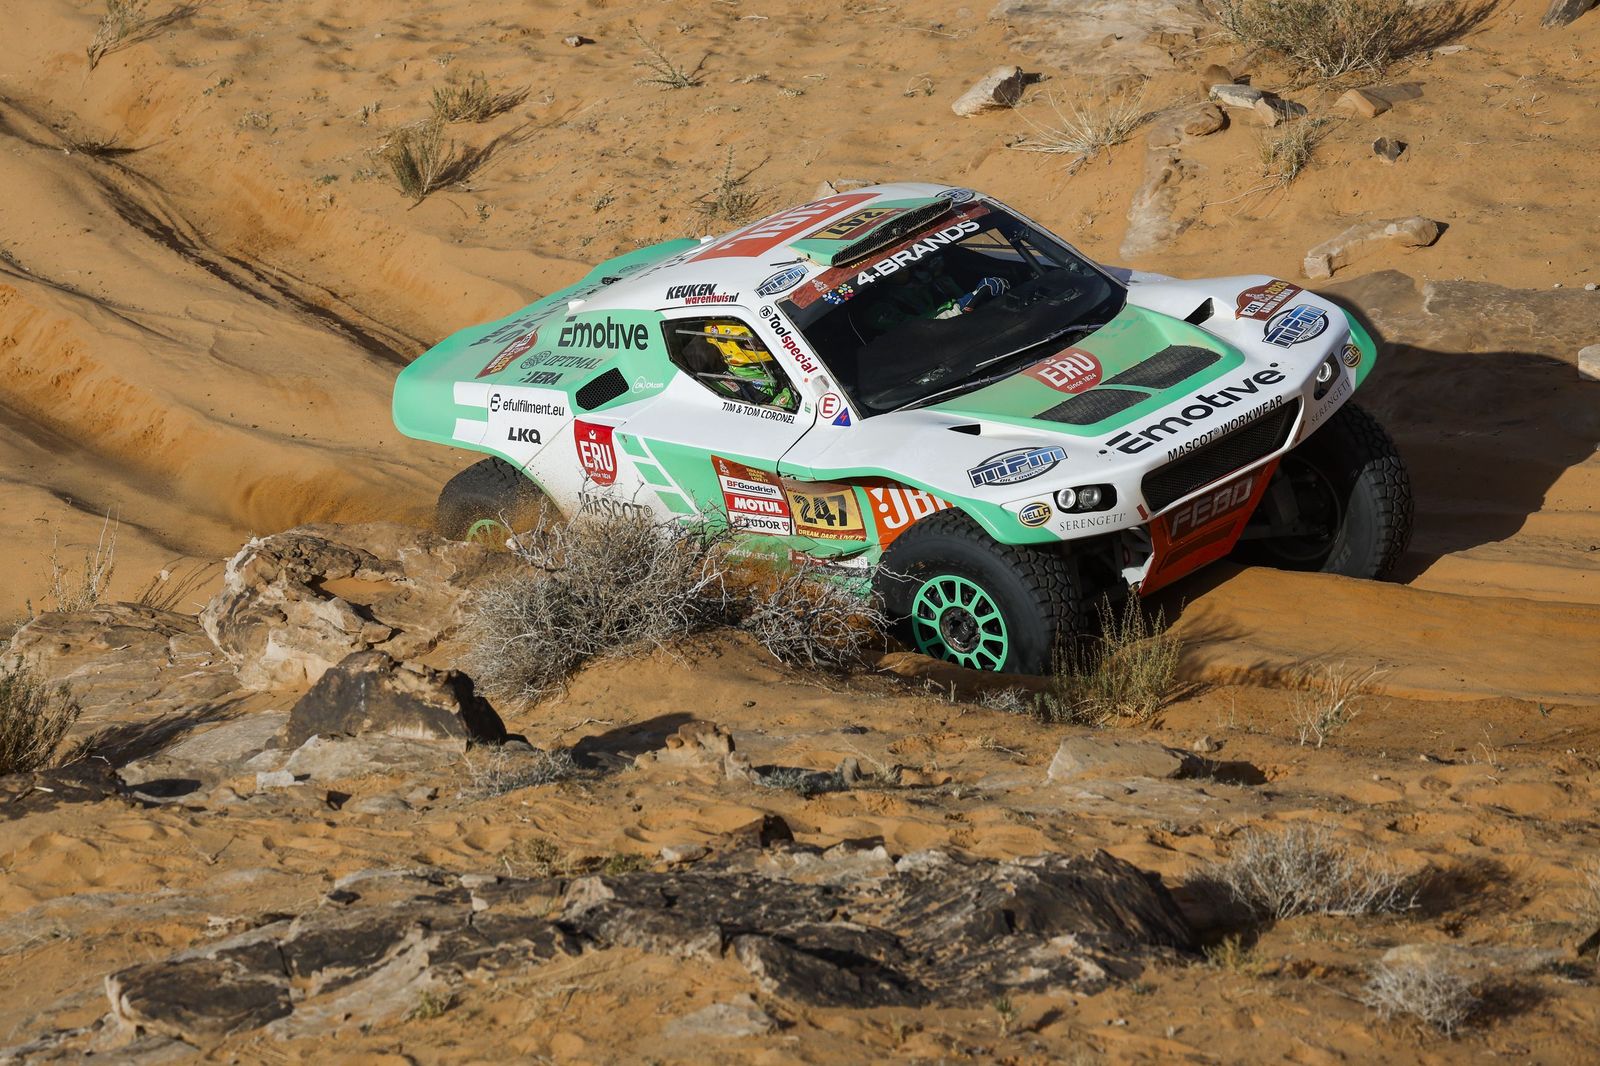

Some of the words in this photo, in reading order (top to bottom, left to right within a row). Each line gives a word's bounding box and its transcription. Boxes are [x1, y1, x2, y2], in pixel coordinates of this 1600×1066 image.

[666, 284, 717, 300] KEUKEN
[1245, 303, 1261, 314] 247
[768, 313, 818, 374] Toolspecial
[1037, 352, 1096, 388] ERU
[502, 398, 565, 417] efulfilment.eu
[722, 402, 736, 412] TIM
[735, 405, 743, 414] &
[743, 406, 760, 418] TOM
[760, 409, 796, 425] CORONEL
[1220, 394, 1284, 433] WORKWEAR
[508, 427, 542, 445] LKQ
[579, 440, 614, 472] ERU
[727, 480, 777, 495] BFGoodrich
[734, 498, 783, 514] MOTUL
[792, 494, 848, 527] 247
[1022, 505, 1051, 521] HELLA
[743, 519, 781, 530] TUDOR
